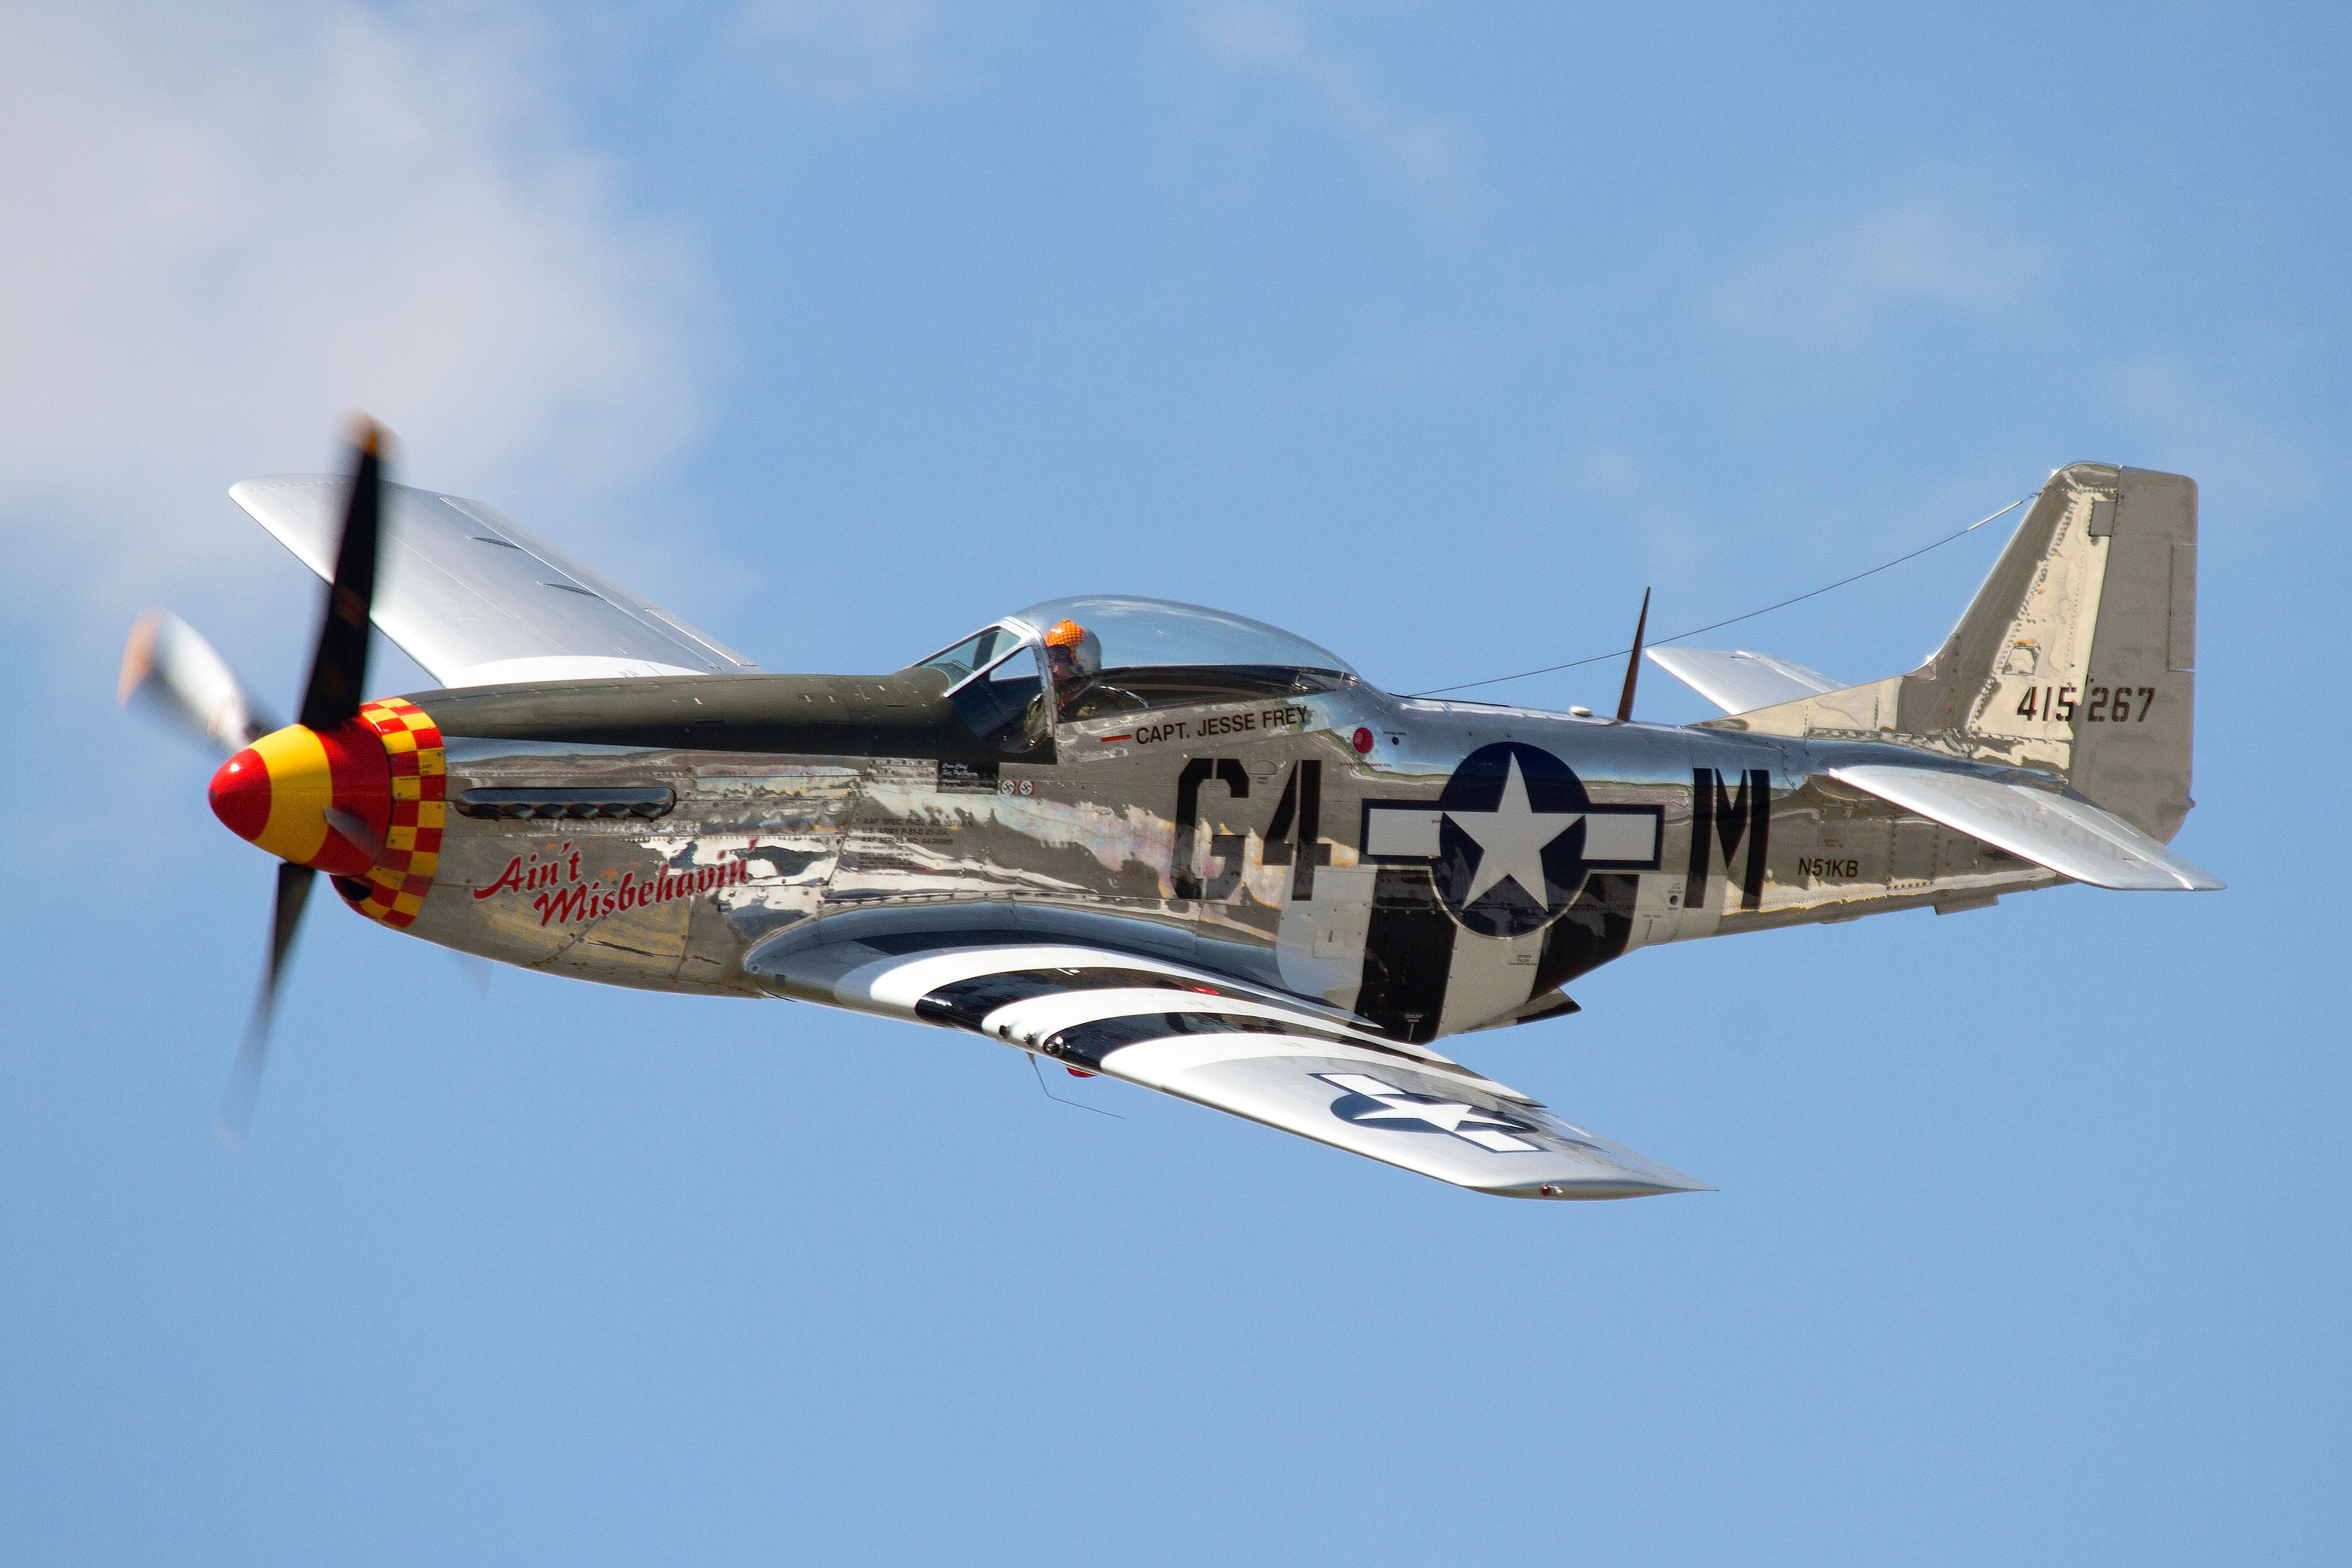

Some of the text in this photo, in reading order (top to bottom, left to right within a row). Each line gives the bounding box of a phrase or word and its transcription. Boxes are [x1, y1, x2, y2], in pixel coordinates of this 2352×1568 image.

[1136, 706, 1307, 745] CAPT. JESSE FREY
[1172, 759, 1331, 901] G4
[1684, 767, 1771, 910] M
[473, 841, 581, 900] Ain't
[533, 838, 758, 927] Misbehavin'
[1798, 858, 1859, 878] N51KB
